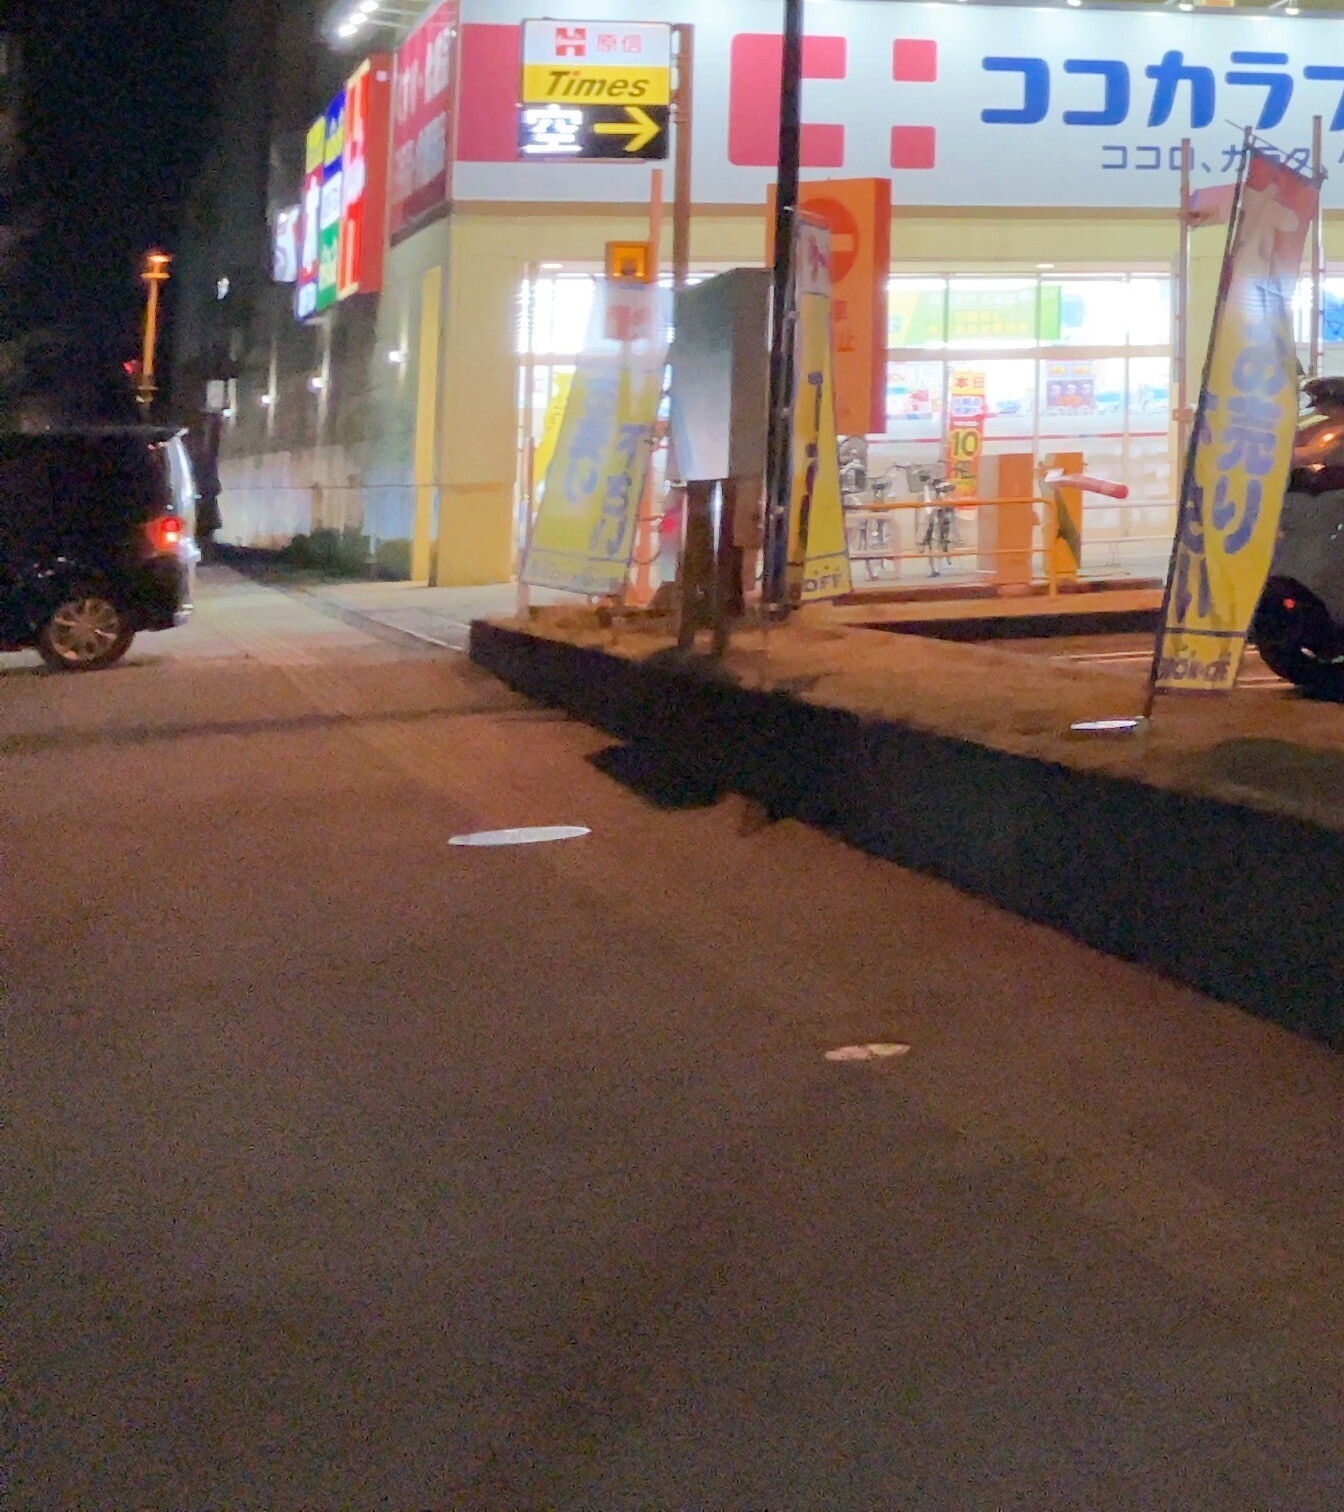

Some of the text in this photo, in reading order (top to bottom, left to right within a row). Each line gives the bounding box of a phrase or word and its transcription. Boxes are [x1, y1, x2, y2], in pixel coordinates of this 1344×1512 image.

[547, 70, 650, 98] Times
[521, 103, 584, 155] 空
[952, 431, 979, 457] 10
